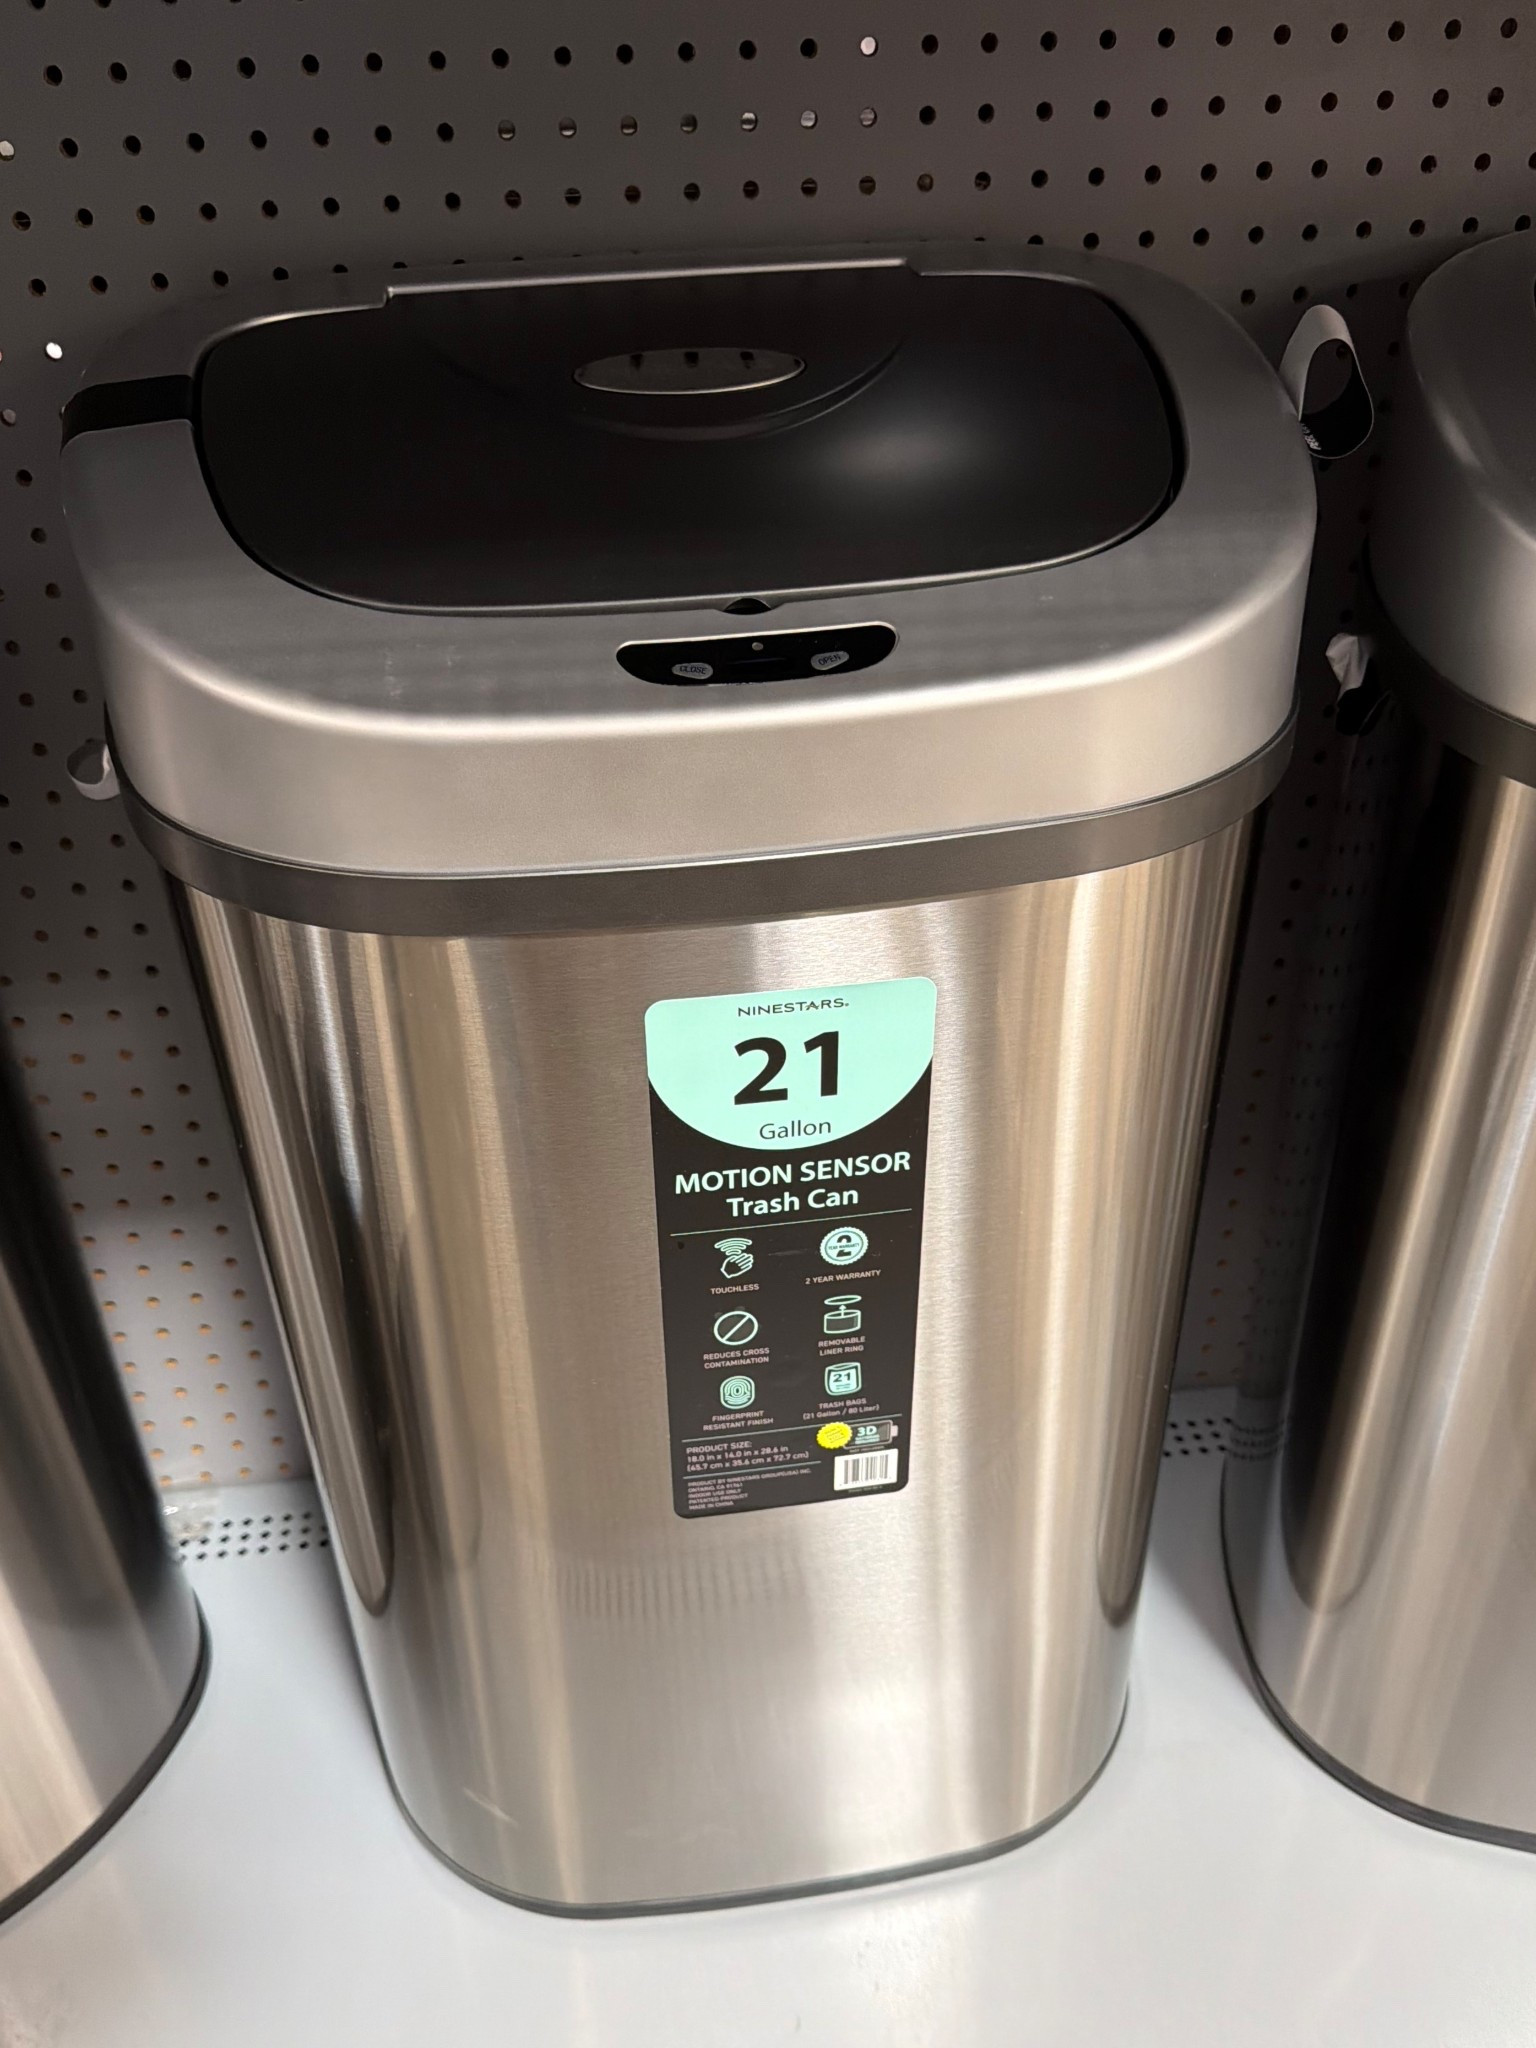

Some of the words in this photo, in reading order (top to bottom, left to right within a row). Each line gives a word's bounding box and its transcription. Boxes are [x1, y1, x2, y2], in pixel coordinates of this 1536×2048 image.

[817, 653, 842, 666] OPEN
[679, 665, 708, 676] CLOSE
[733, 1030, 840, 1106] 21
[759, 1120, 832, 1140] Gallon
[674, 1163, 792, 1195] MOTION
[799, 1151, 911, 1182] SENSOR
[726, 1192, 799, 1217] Trash
[807, 1188, 859, 1209] Can
[812, 1274, 834, 1283] YEAR
[835, 1269, 881, 1281] WARRANTY
[710, 1283, 760, 1295] TOUCHLESS
[818, 1336, 866, 1348] REMOVABLE
[703, 1350, 742, 1361] REDUCES
[743, 1347, 770, 1357] CROSS
[819, 1346, 843, 1356] LINER
[844, 1344, 864, 1354] RING
[704, 1356, 770, 1370] CONTAMINATION
[833, 1371, 851, 1383] 21
[819, 1400, 845, 1410] TRASH
[846, 1397, 867, 1407] BAGS
[712, 1410, 764, 1422] FINGERPRINT
[803, 1411, 815, 1421] (21
[816, 1408, 841, 1418] Gallon
[842, 1406, 847, 1416] /
[859, 1403, 880, 1414] Liter)
[703, 1420, 746, 1431] RESISTANT
[747, 1417, 774, 1427] FINISH
[857, 1425, 878, 1437] 3D
[686, 1443, 730, 1454] PRODUCT
[730, 1440, 753, 1450] SIZE:
[687, 1454, 705, 1463] 18.0
[706, 1453, 715, 1461] in
[724, 1451, 742, 1459] 14.0
[743, 1449, 752, 1457] in
[760, 1447, 778, 1455] 28.6
[732, 1459, 750, 1467] 35.6
[751, 1457, 764, 1465] cm
[773, 1454, 791, 1462] 72.7
[792, 1451, 809, 1460] cm)
[688, 1479, 717, 1487] PRODUCT
